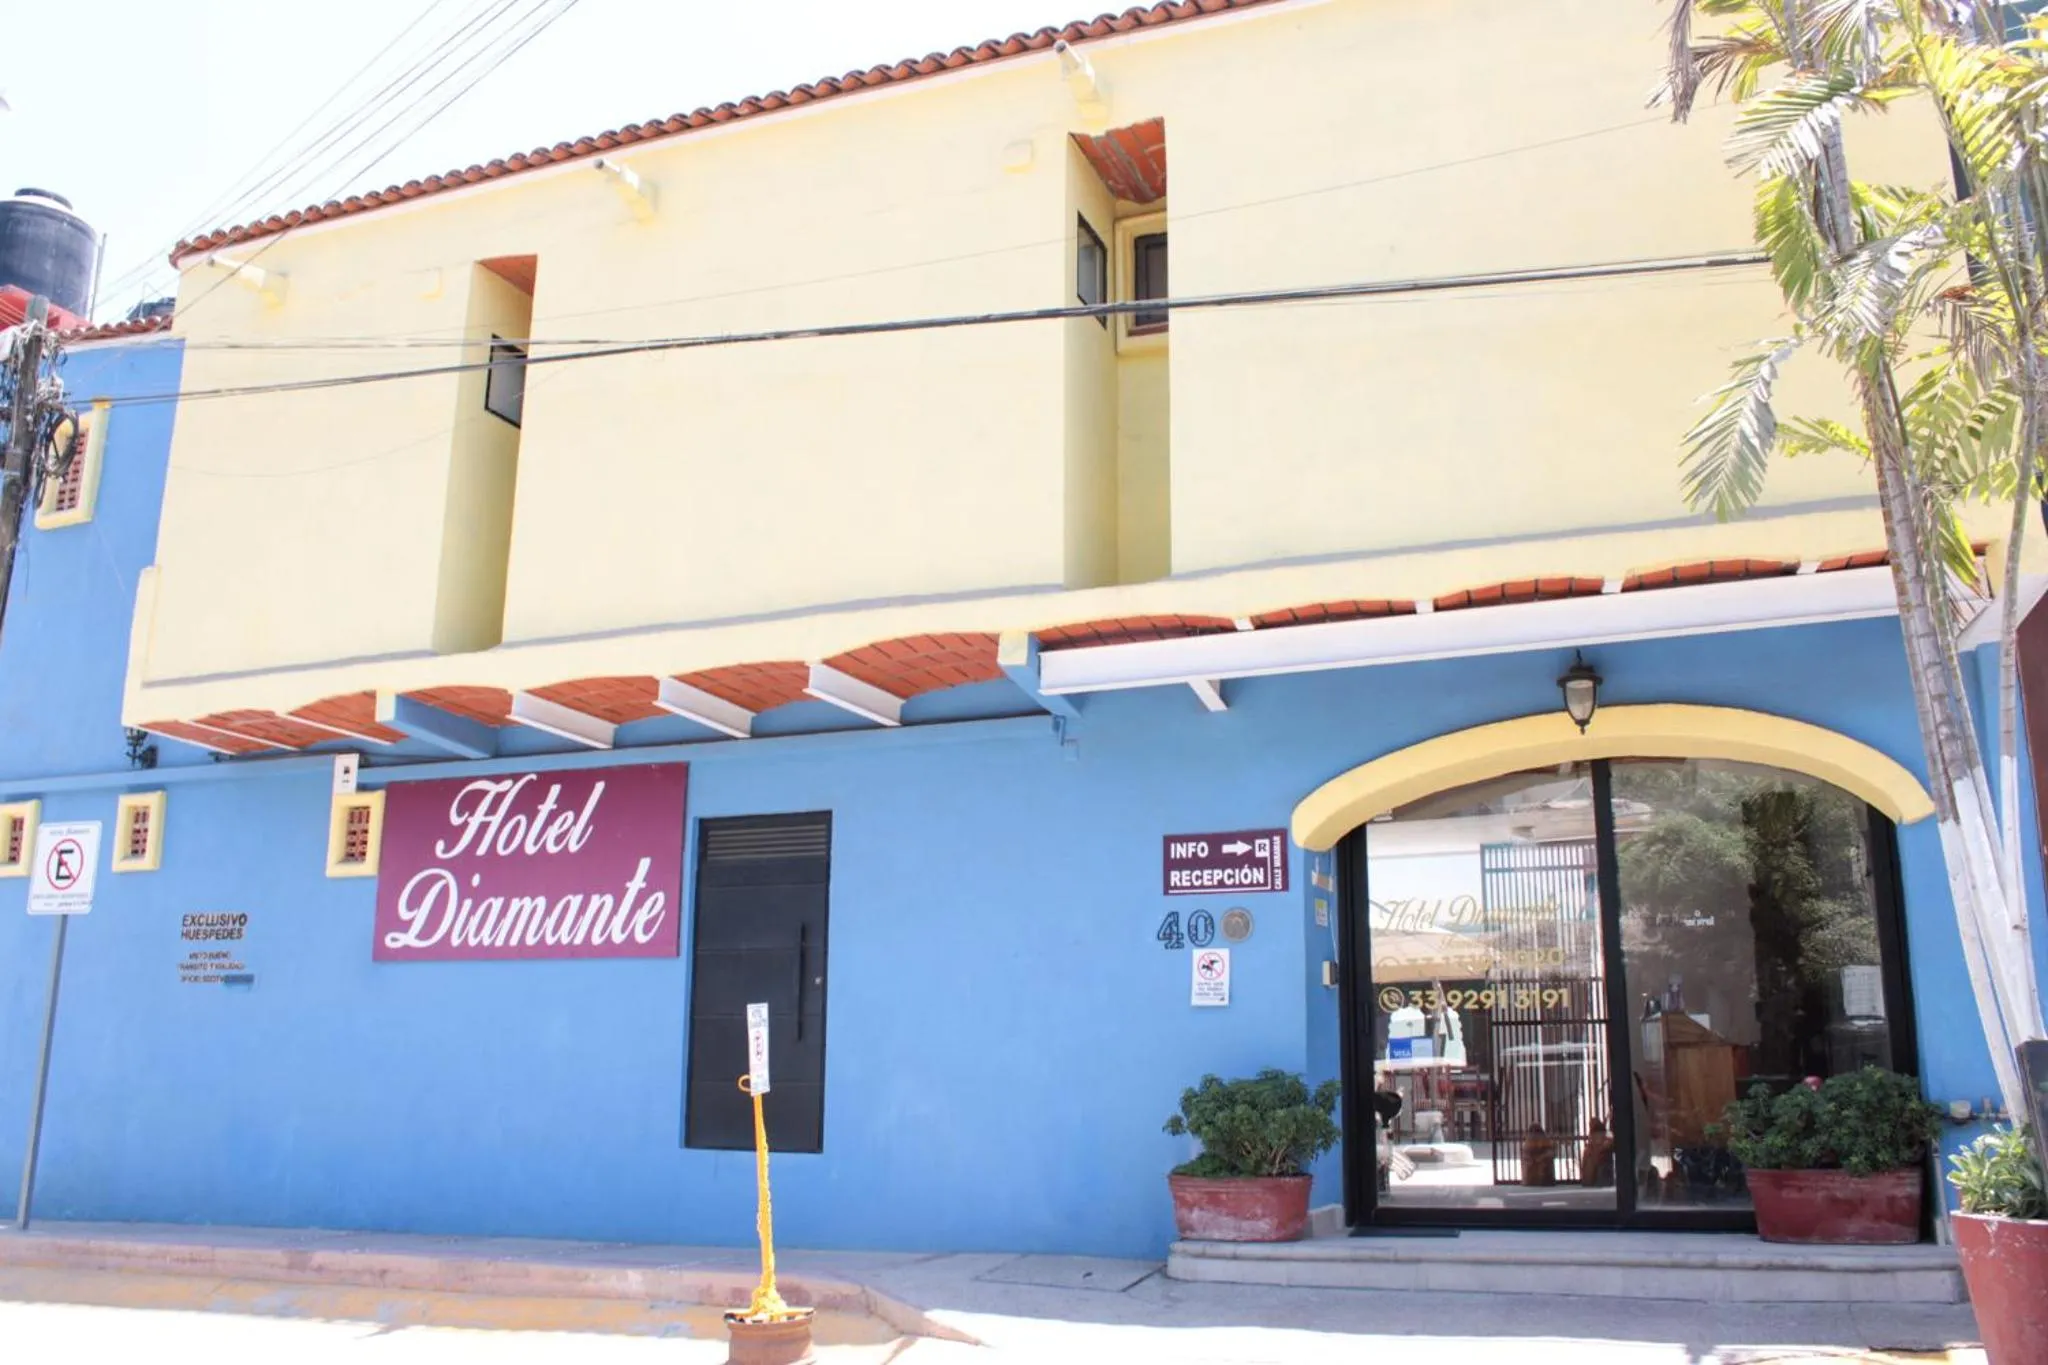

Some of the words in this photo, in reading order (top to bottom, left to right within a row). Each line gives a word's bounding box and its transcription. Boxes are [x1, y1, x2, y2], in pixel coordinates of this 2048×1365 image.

[435, 774, 605, 859] Hotel
[1170, 841, 1209, 859] INFO
[1170, 864, 1265, 887] RECEPCIÓN
[384, 857, 666, 949] Diamante
[1381, 896, 1442, 933] Hotel
[182, 913, 248, 928] EXCLUSIVO
[1157, 908, 1215, 950] 40
[181, 927, 243, 941] HUESPEDES
[1408, 990, 1437, 1010] 33
[1449, 989, 1508, 1010] 9291
[1514, 987, 1572, 1010] 3191
